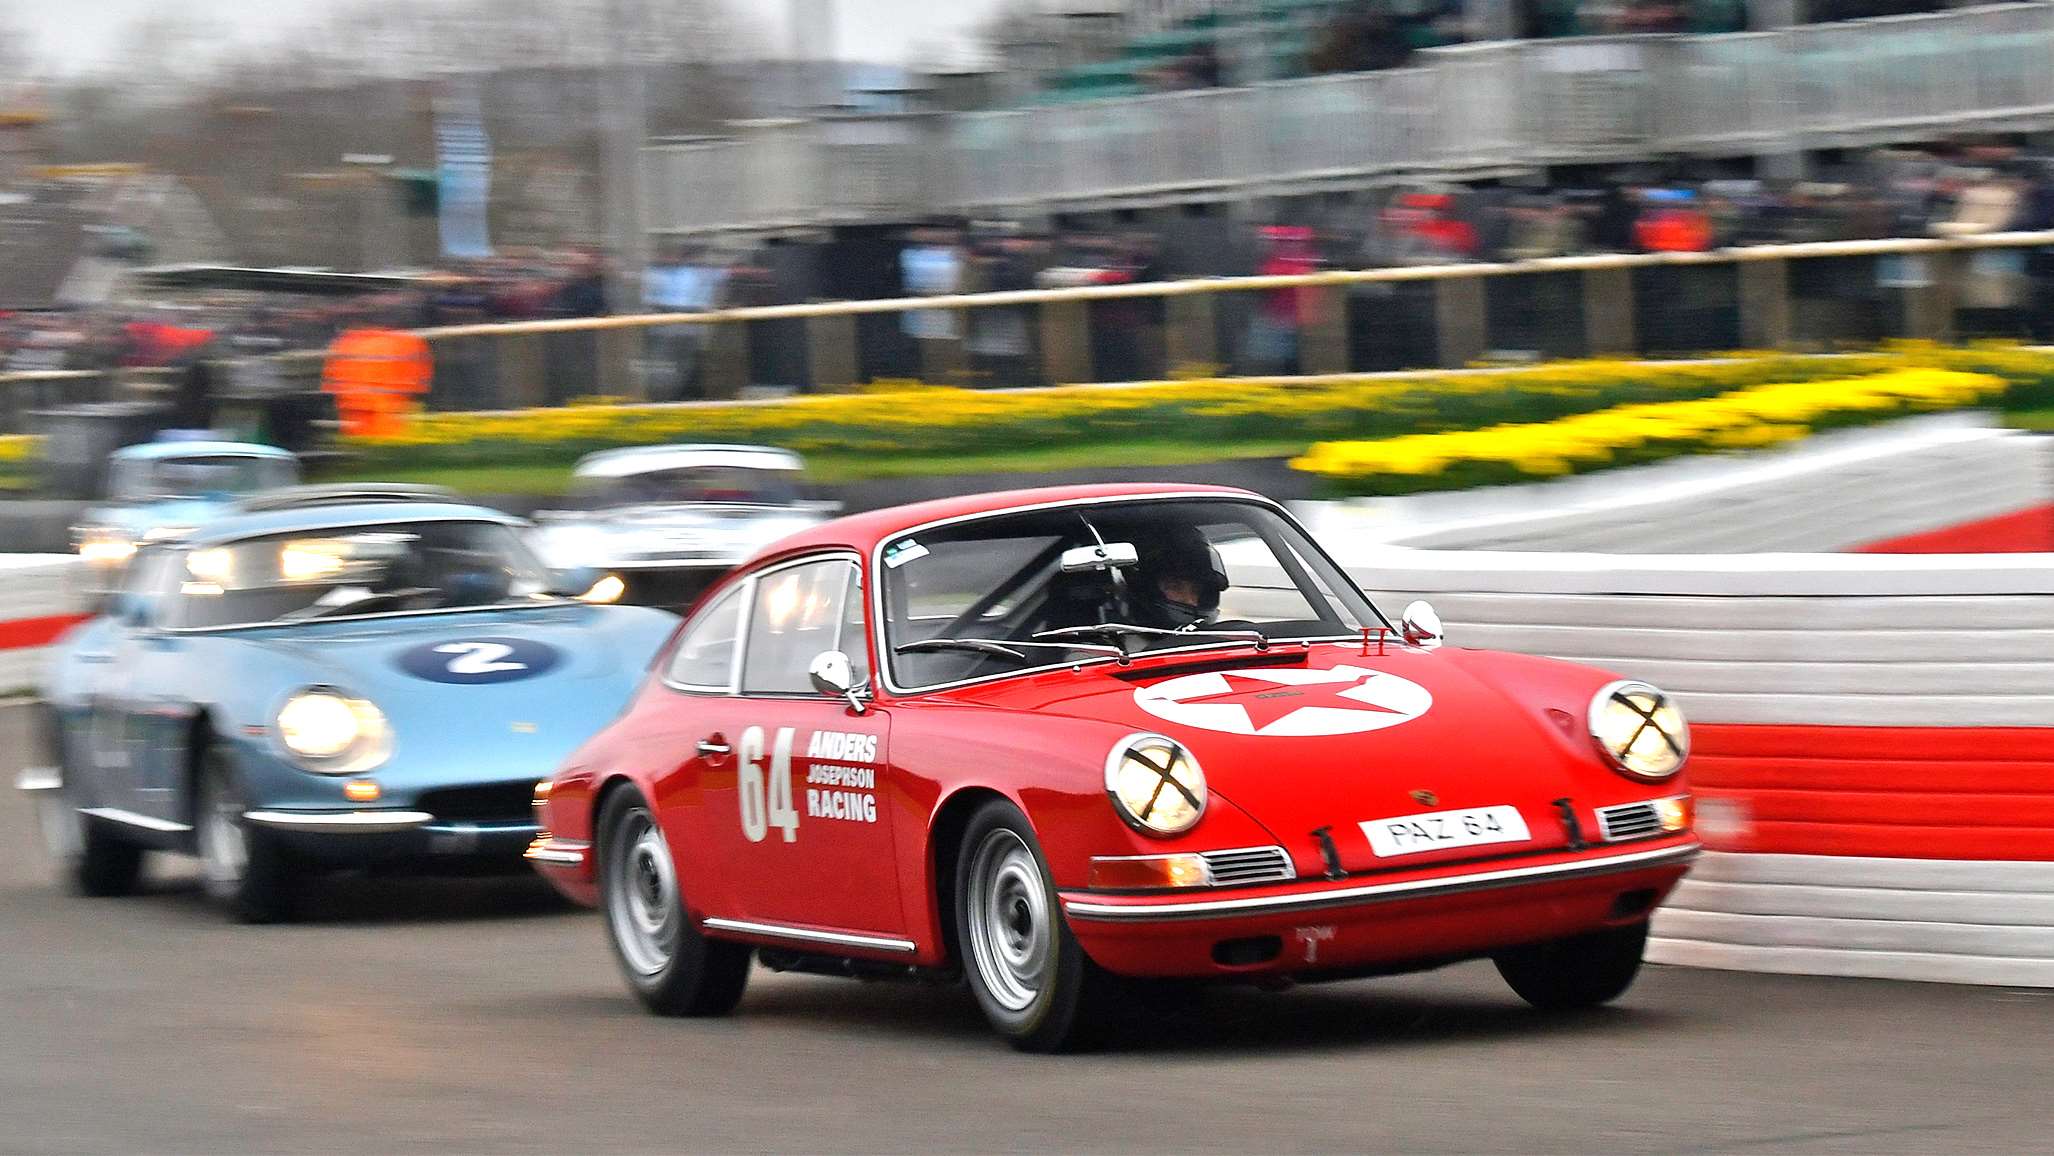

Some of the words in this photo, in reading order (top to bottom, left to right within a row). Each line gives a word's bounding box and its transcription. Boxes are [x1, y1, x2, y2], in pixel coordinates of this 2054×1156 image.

[432, 642, 528, 673] 2
[807, 730, 877, 762] ANDERS
[739, 726, 799, 842] 64
[807, 764, 875, 788] JOSEPHSON
[807, 789, 877, 822] RACING
[1387, 818, 1454, 846] PAZ
[1462, 813, 1504, 837] 64
